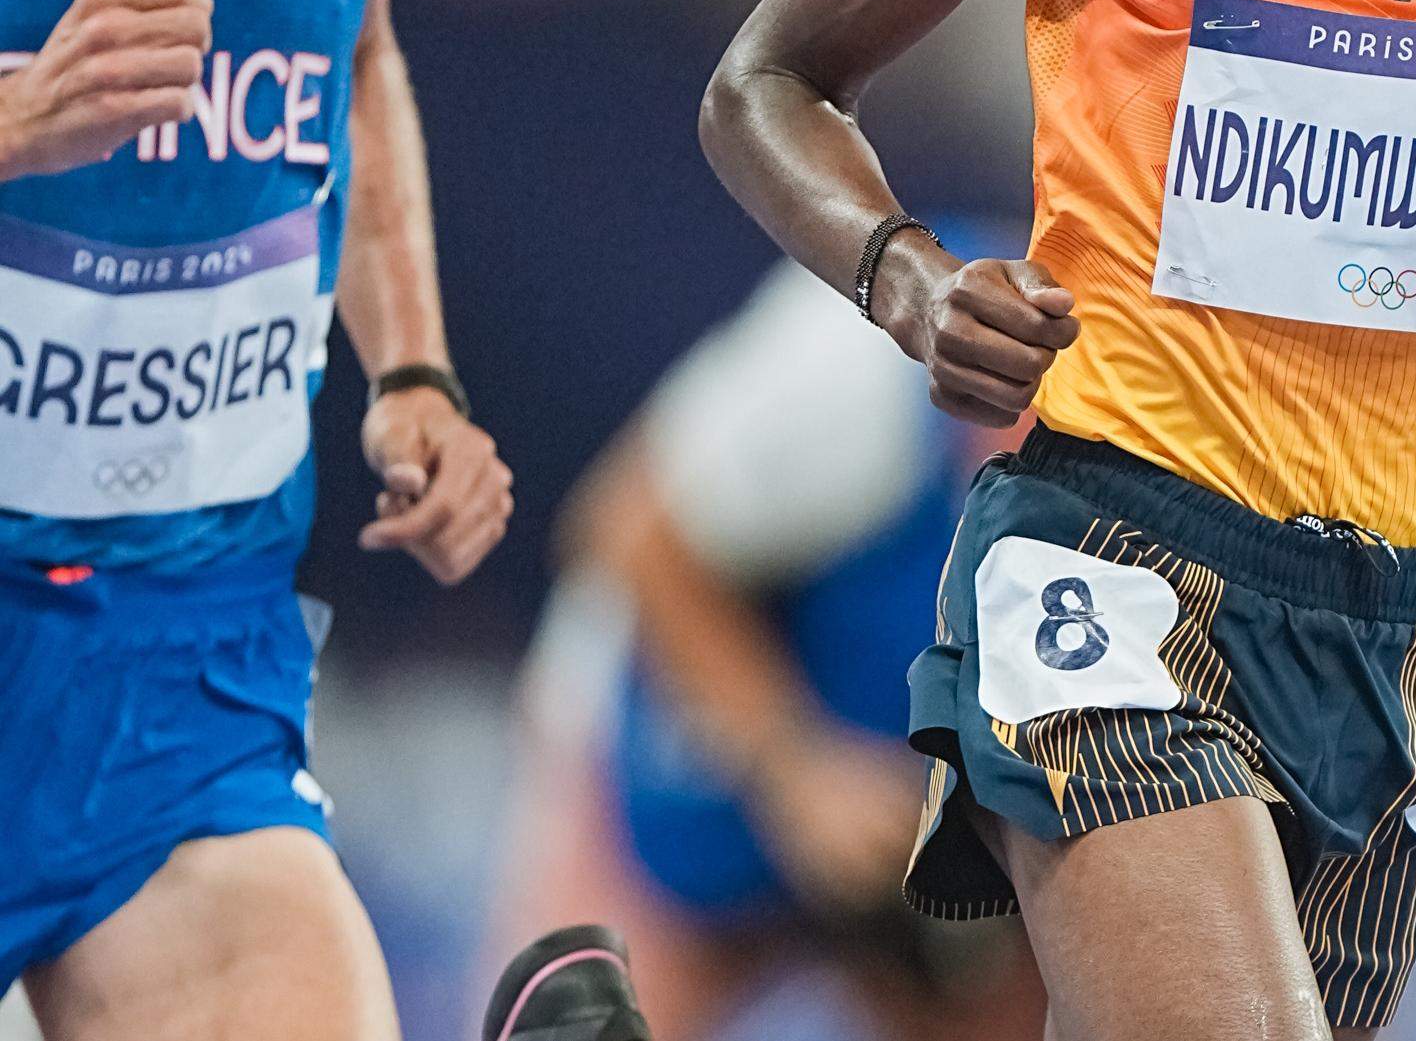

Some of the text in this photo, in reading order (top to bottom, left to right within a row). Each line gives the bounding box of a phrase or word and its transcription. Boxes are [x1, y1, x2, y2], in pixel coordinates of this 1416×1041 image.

[0, 49, 332, 164] NCE
[72, 249, 173, 286] PARIS
[1034, 576, 1110, 671] 8
